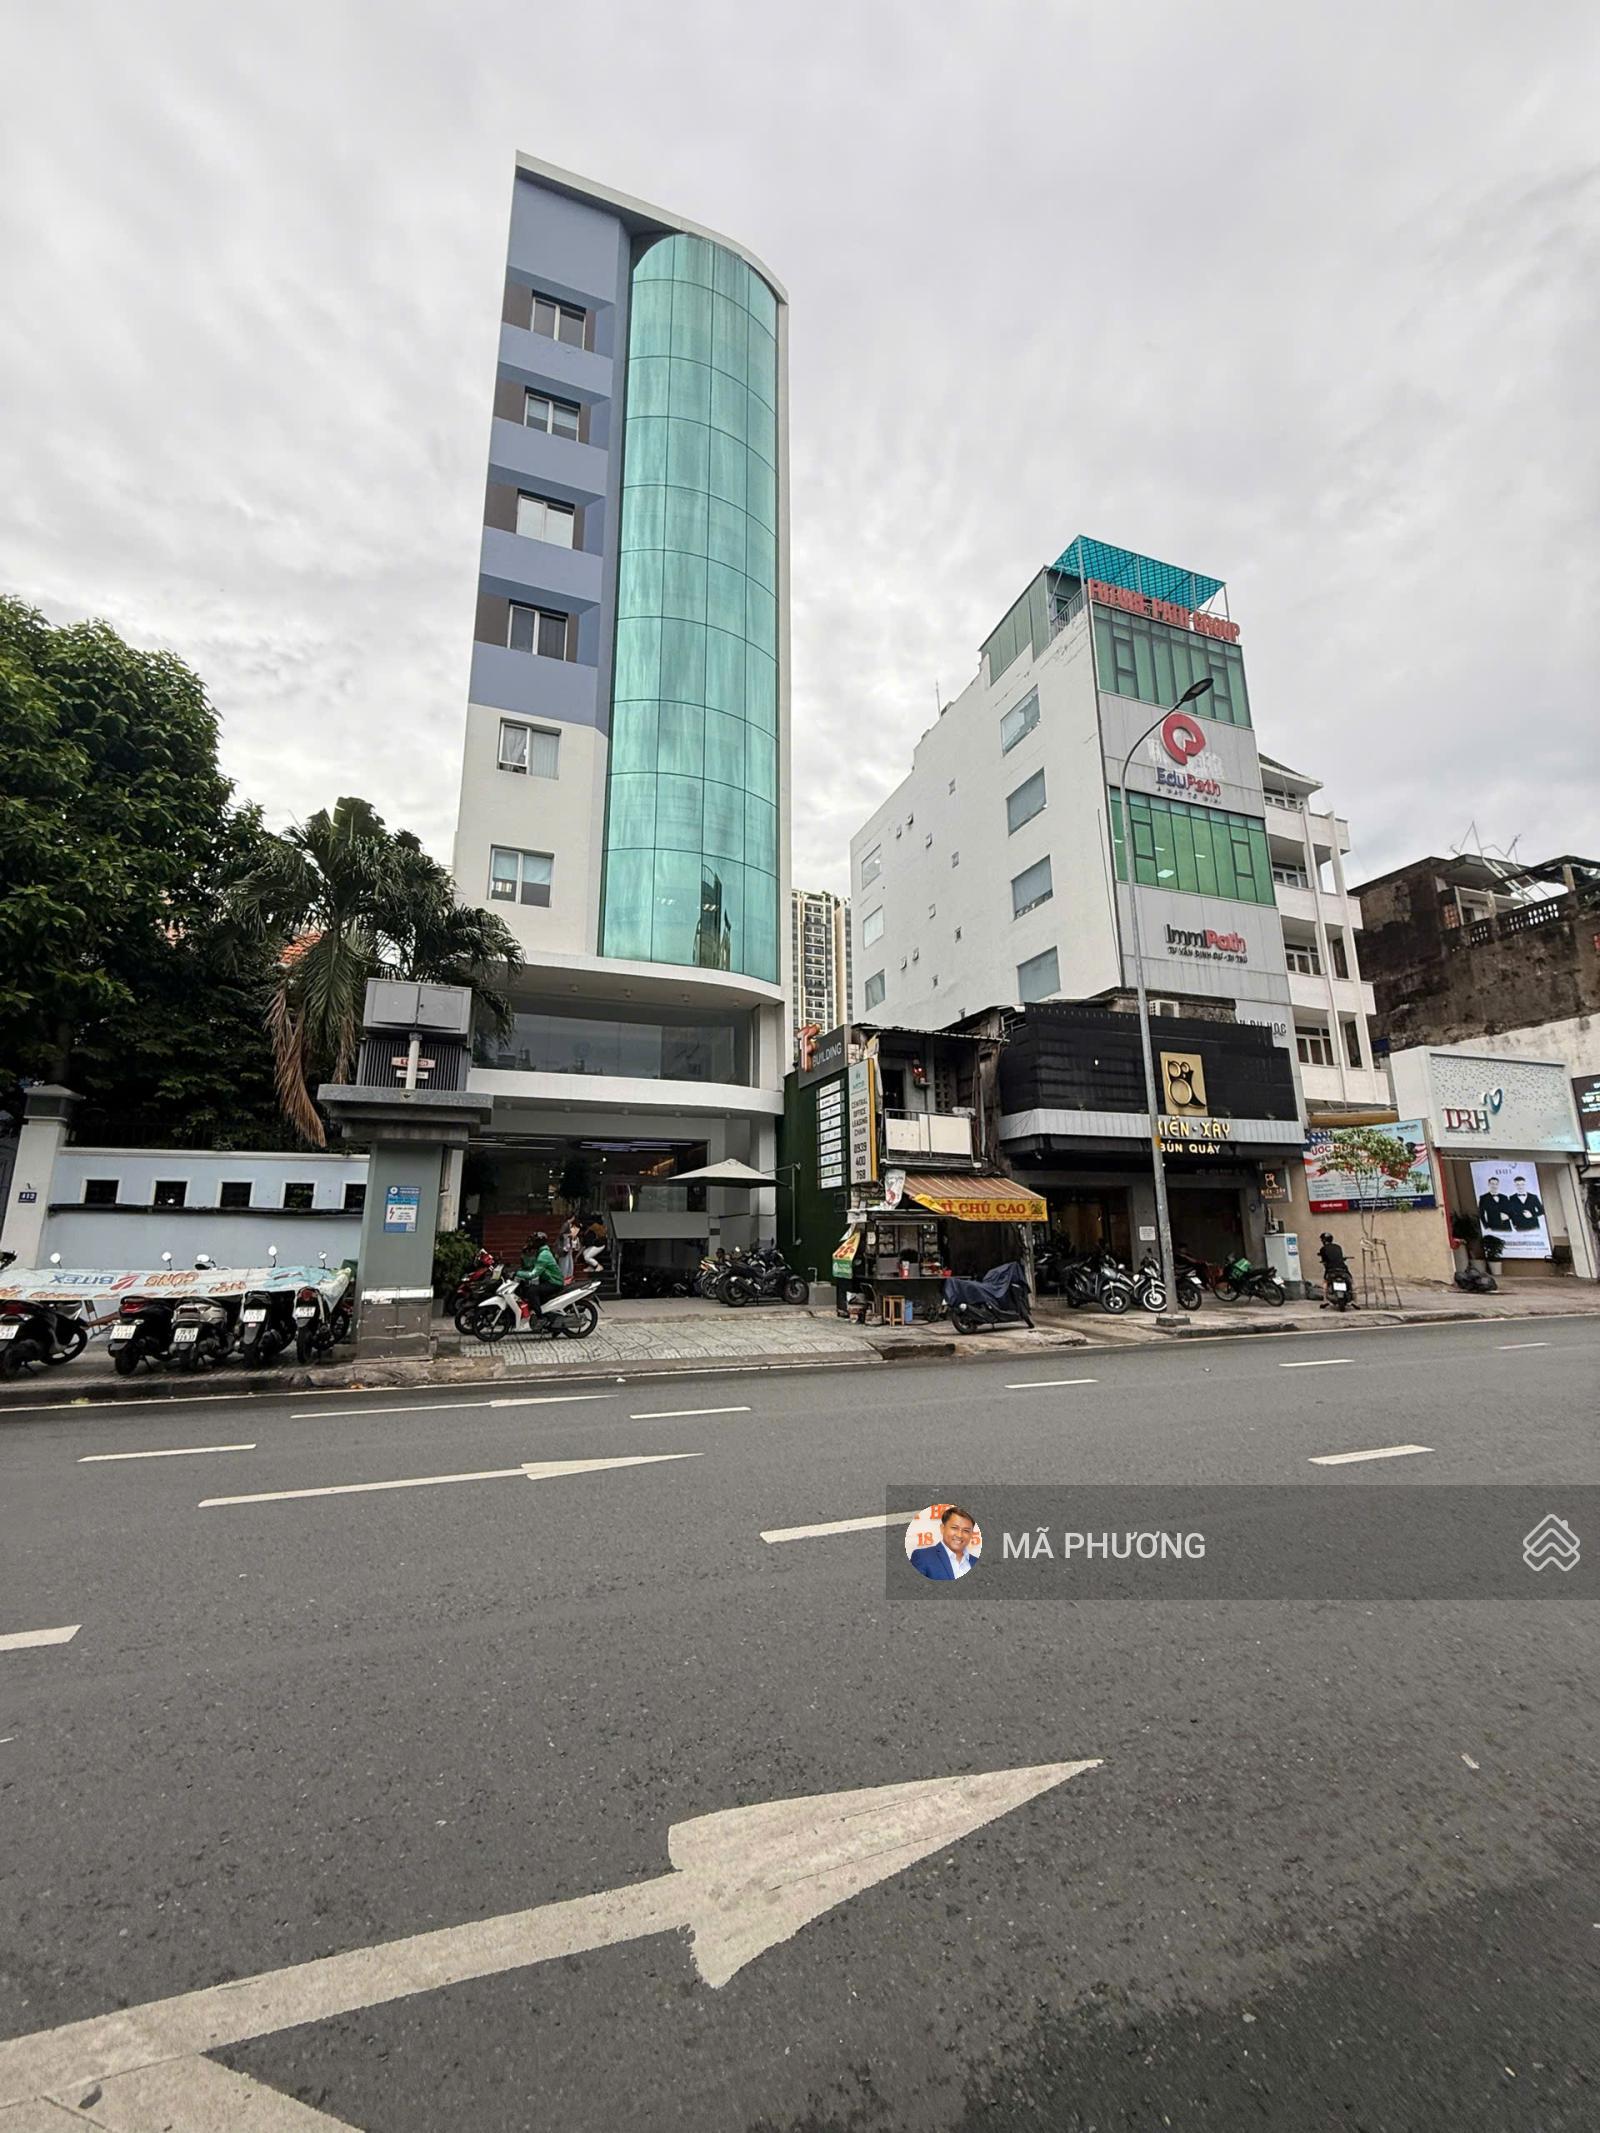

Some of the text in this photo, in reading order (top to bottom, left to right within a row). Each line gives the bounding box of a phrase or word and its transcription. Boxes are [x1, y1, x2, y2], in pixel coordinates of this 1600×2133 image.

[1193, 611, 1241, 643] GROUP
[1156, 767, 1221, 797] EduPath
[813, 1042, 842, 1068] BUILDING
[1200, 1118, 1230, 1138] XÂY
[1160, 1140, 1220, 1155] BÚN QUẬY
[959, 1201, 991, 1214] CHÚ
[996, 1203, 1026, 1214] CAO
